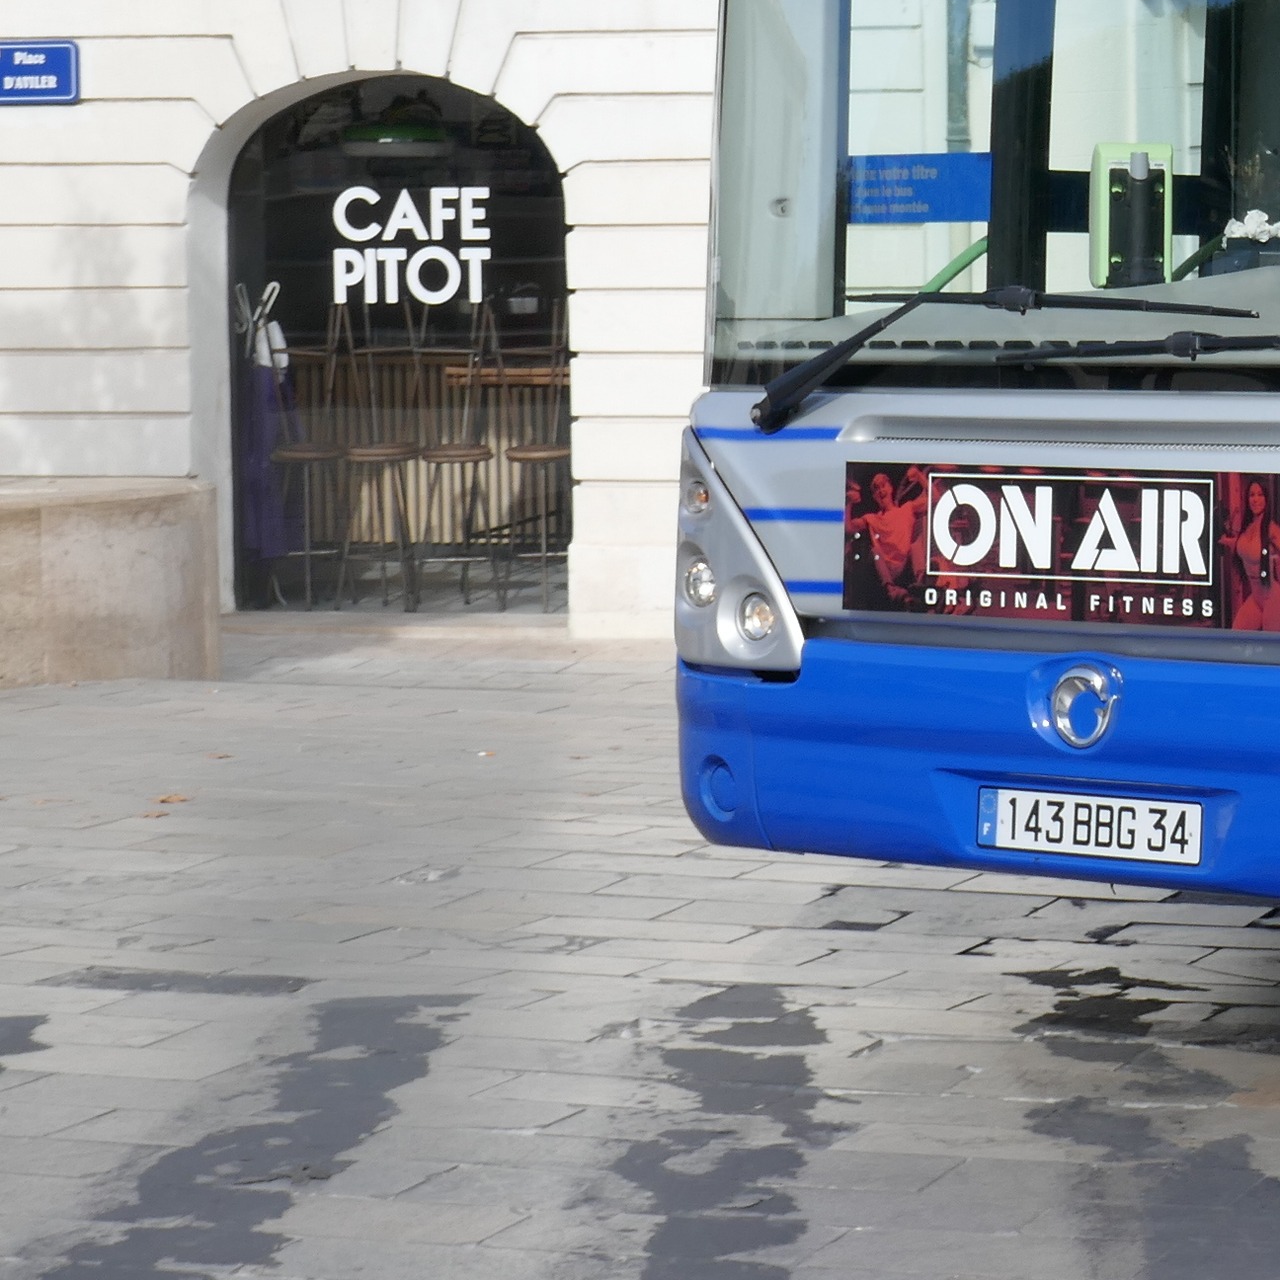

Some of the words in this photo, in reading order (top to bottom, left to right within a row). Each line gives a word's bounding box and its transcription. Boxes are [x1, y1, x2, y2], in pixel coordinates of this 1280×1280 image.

[13, 51, 46, 65] Place
[332, 185, 491, 242] CAFE
[332, 245, 492, 305] PITOT
[932, 484, 1053, 569] ON
[1071, 488, 1207, 574] AIR
[924, 588, 1067, 611] ORIGINAL
[1089, 595, 1214, 617] FITNESS
[982, 822, 991, 835] F
[1009, 797, 1065, 843] 143
[1072, 802, 1136, 849] BBG
[1147, 808, 1189, 854] 34
